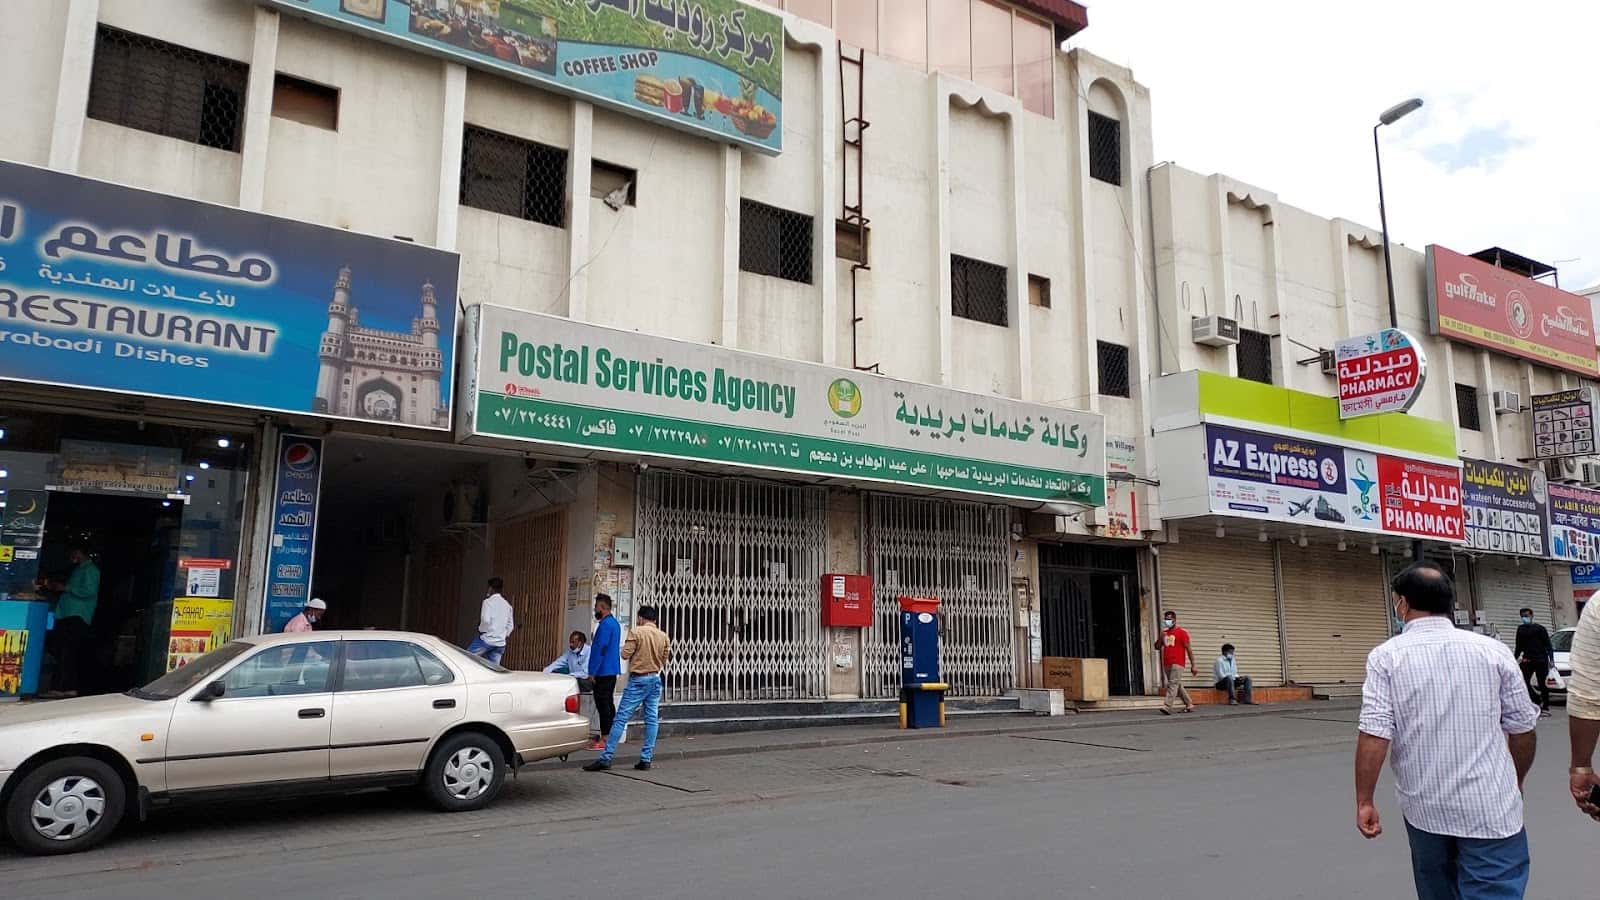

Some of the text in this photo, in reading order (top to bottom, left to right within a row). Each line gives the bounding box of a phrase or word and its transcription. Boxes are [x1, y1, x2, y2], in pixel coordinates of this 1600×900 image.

[717, 8, 774, 67] مركز
[564, 51, 659, 78] COFFEE SHOP
[44, 226, 273, 283] مطاعم
[38, 263, 136, 292] الهندية
[142, 283, 236, 308] للأكلات
[0, 289, 276, 353] RESTAURANT
[0, 329, 209, 368] rabadi Dishes
[499, 331, 796, 419] Postal Services Agency
[1339, 353, 1413, 381] صيدلية
[1341, 371, 1413, 397] PHARMACY
[894, 391, 1088, 458] وكالة خدمات بريدية
[840, 451, 853, 469] بن
[855, 454, 887, 471] الوهاب
[888, 458, 907, 474] عبد
[1213, 438, 1319, 484] AZ Express
[972, 466, 1009, 486] البريدية
[1401, 471, 1459, 511] صيدلية
[1385, 508, 1461, 536] PHARMACY
